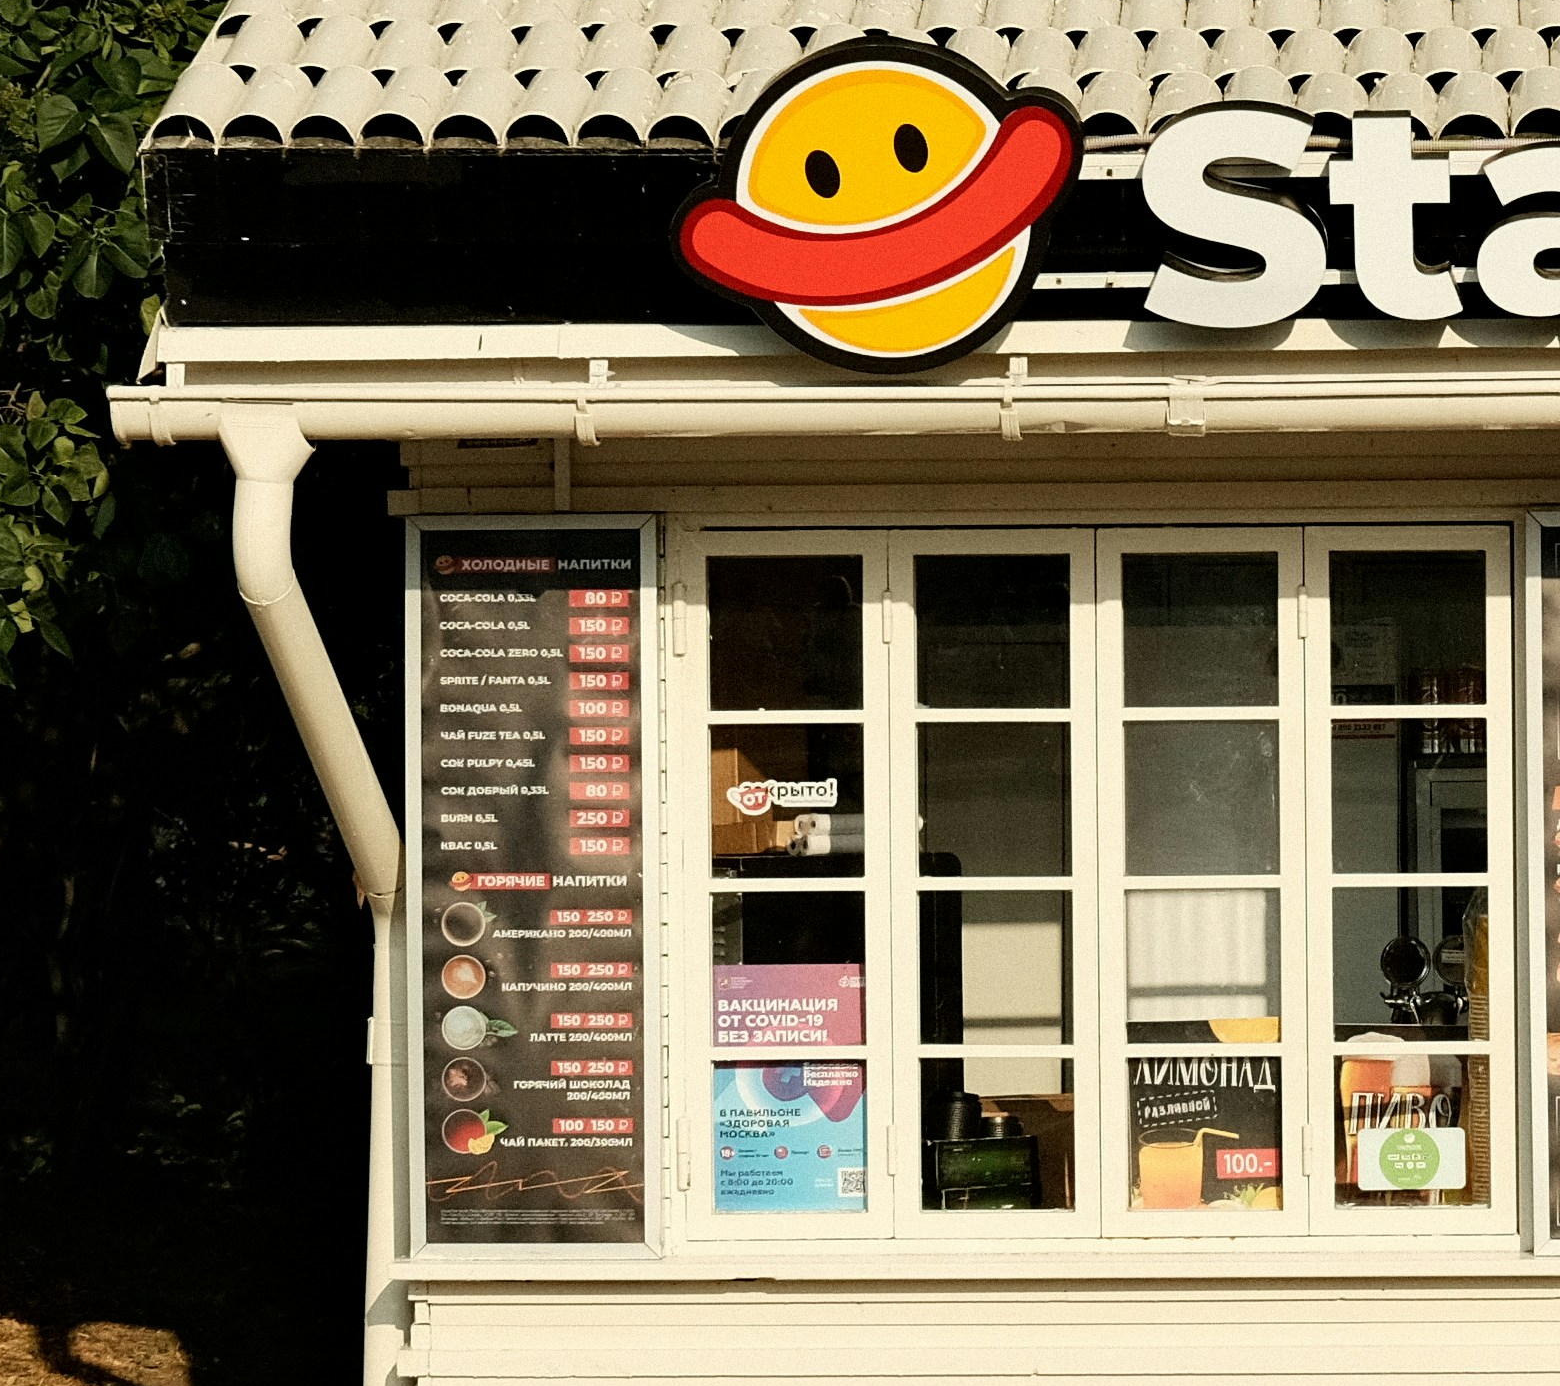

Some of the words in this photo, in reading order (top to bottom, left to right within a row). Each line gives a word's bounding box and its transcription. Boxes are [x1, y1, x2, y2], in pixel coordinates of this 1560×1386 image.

[461, 559, 550, 573] ХОЛОДНЫЕ
[558, 559, 632, 571] НАПИТКИ
[440, 594, 505, 603] COCA-COLA
[585, 592, 606, 604] 80
[440, 621, 505, 630] COCA-COLA
[579, 619, 606, 632] 150
[440, 649, 506, 658] COCA-COLA
[507, 649, 538, 658] ZERO
[579, 647, 606, 659] 150
[440, 676, 478, 685] SPRITE
[489, 676, 525, 685] FANTA
[579, 674, 606, 687] 150
[440, 704, 497, 715] BONAQUA
[578, 702, 606, 714] 100
[440, 730, 464, 740] ЧАЙ
[468, 732, 496, 740] FUZE
[499, 731, 521, 740] TEA
[579, 729, 606, 742] 150
[579, 757, 607, 769] 150
[466, 785, 519, 797] ДОБРЫЙ
[585, 784, 607, 797] 80
[441, 814, 473, 823] BURN
[576, 812, 607, 825] 250
[441, 841, 472, 850] КВАС
[579, 839, 607, 852] 150
[477, 875, 545, 888] ГОРЯЧИЕ
[552, 875, 627, 888] НАПИТКИ
[557, 911, 580, 923] 150
[587, 911, 614, 923] 250
[492, 929, 567, 939] АМЕРИКАНО
[557, 964, 581, 976] 150
[587, 964, 615, 976] 250
[502, 982, 567, 992] КАПУЧИНО
[718, 998, 838, 1014] ВАКЦИНАЦИЯ
[557, 1014, 581, 1026] 150
[588, 1014, 615, 1026] 250
[718, 1015, 742, 1027] ОТ
[745, 1014, 825, 1027] COVID-19
[529, 1033, 567, 1043] ЛАТТЕ
[718, 1031, 749, 1043] БЕЗ
[752, 1029, 828, 1043] ЗАПИСИ!
[557, 1062, 581, 1073] 150
[588, 1062, 615, 1073] 250
[1134, 1058, 1277, 1094] ЛИМОНАД
[513, 1078, 567, 1089] ГОРЯЧИЙ
[569, 1080, 632, 1090] ШОКОЛАД
[720, 1109, 729, 1118] В
[730, 1108, 801, 1118] ПАВИЛЬОНЕ
[1144, 1096, 1211, 1119] РАЗЛИВНОЙ
[1348, 1091, 1453, 1136] ПИВО
[559, 1120, 584, 1131] 100
[591, 1120, 615, 1131] 150
[720, 1119, 791, 1129] «ЗДОРОВАЯ
[720, 1130, 776, 1139] МОСКВА»
[500, 1136, 526, 1148] ЧАЙ
[720, 1169, 736, 1178] Мы
[738, 1169, 784, 1179] работаем
[766, 1178, 794, 1186] 20:00
[720, 1189, 776, 1197] ежедневно
